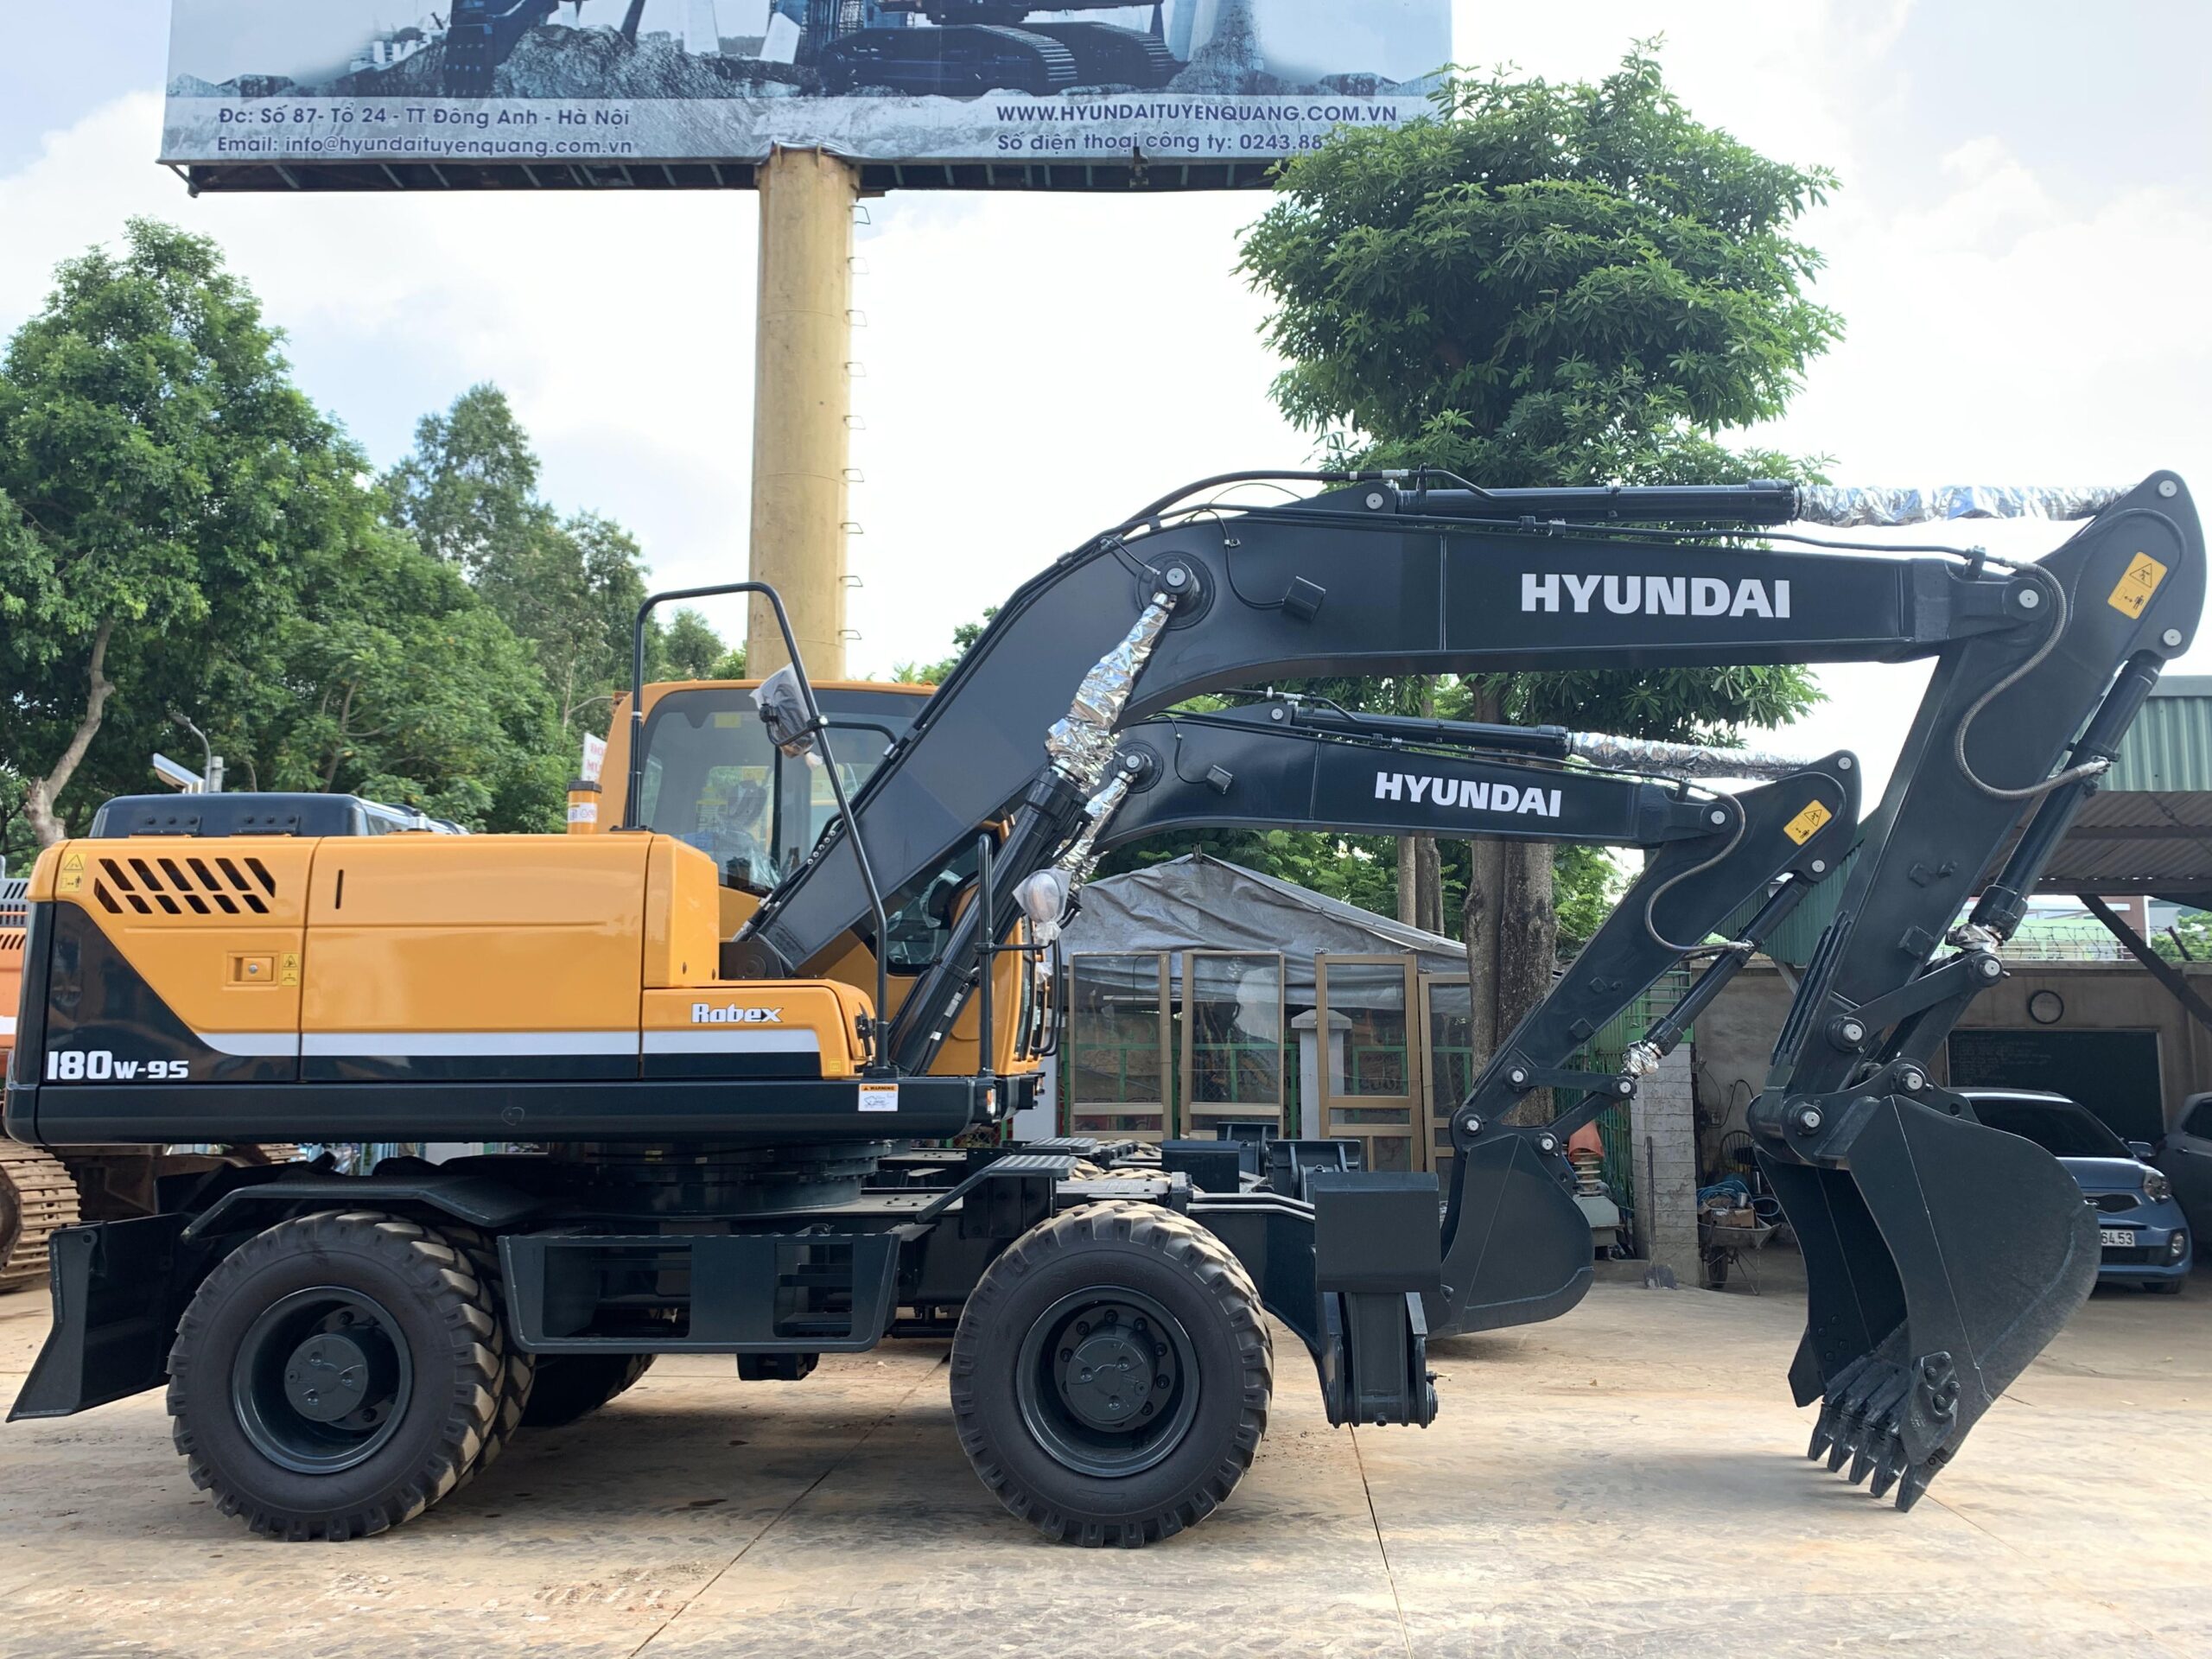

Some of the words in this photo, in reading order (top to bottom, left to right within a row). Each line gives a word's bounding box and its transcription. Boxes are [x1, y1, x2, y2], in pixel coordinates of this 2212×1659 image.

[219, 107, 253, 124] Đc:
[260, 103, 289, 124] Số
[331, 102, 354, 124] Tổ
[361, 107, 387, 124] 24
[405, 107, 427, 124] TT
[433, 107, 489, 129] Đông
[497, 109, 538, 125] Anh
[558, 109, 587, 125] Hà
[594, 108, 629, 130] Nội
[996, 104, 1397, 122] WWW.HYUNDAITUYENQUANG.COM.VN
[218, 136, 278, 152] Email:
[285, 135, 632, 157] info@hyundaituyenquang.com.vn
[998, 130, 1026, 150] Số
[1030, 133, 1077, 155] điện
[1084, 132, 1140, 153] thoại
[1146, 130, 1199, 153] công
[1207, 135, 1232, 153] ty:
[1240, 133, 1324, 150] 0243.88
[1521, 573, 1791, 619] HYUNDAI
[1375, 772, 1562, 817] HYUNDAI
[691, 1002, 784, 1023] Robex
[2101, 1231, 2133, 1245] 64.53
